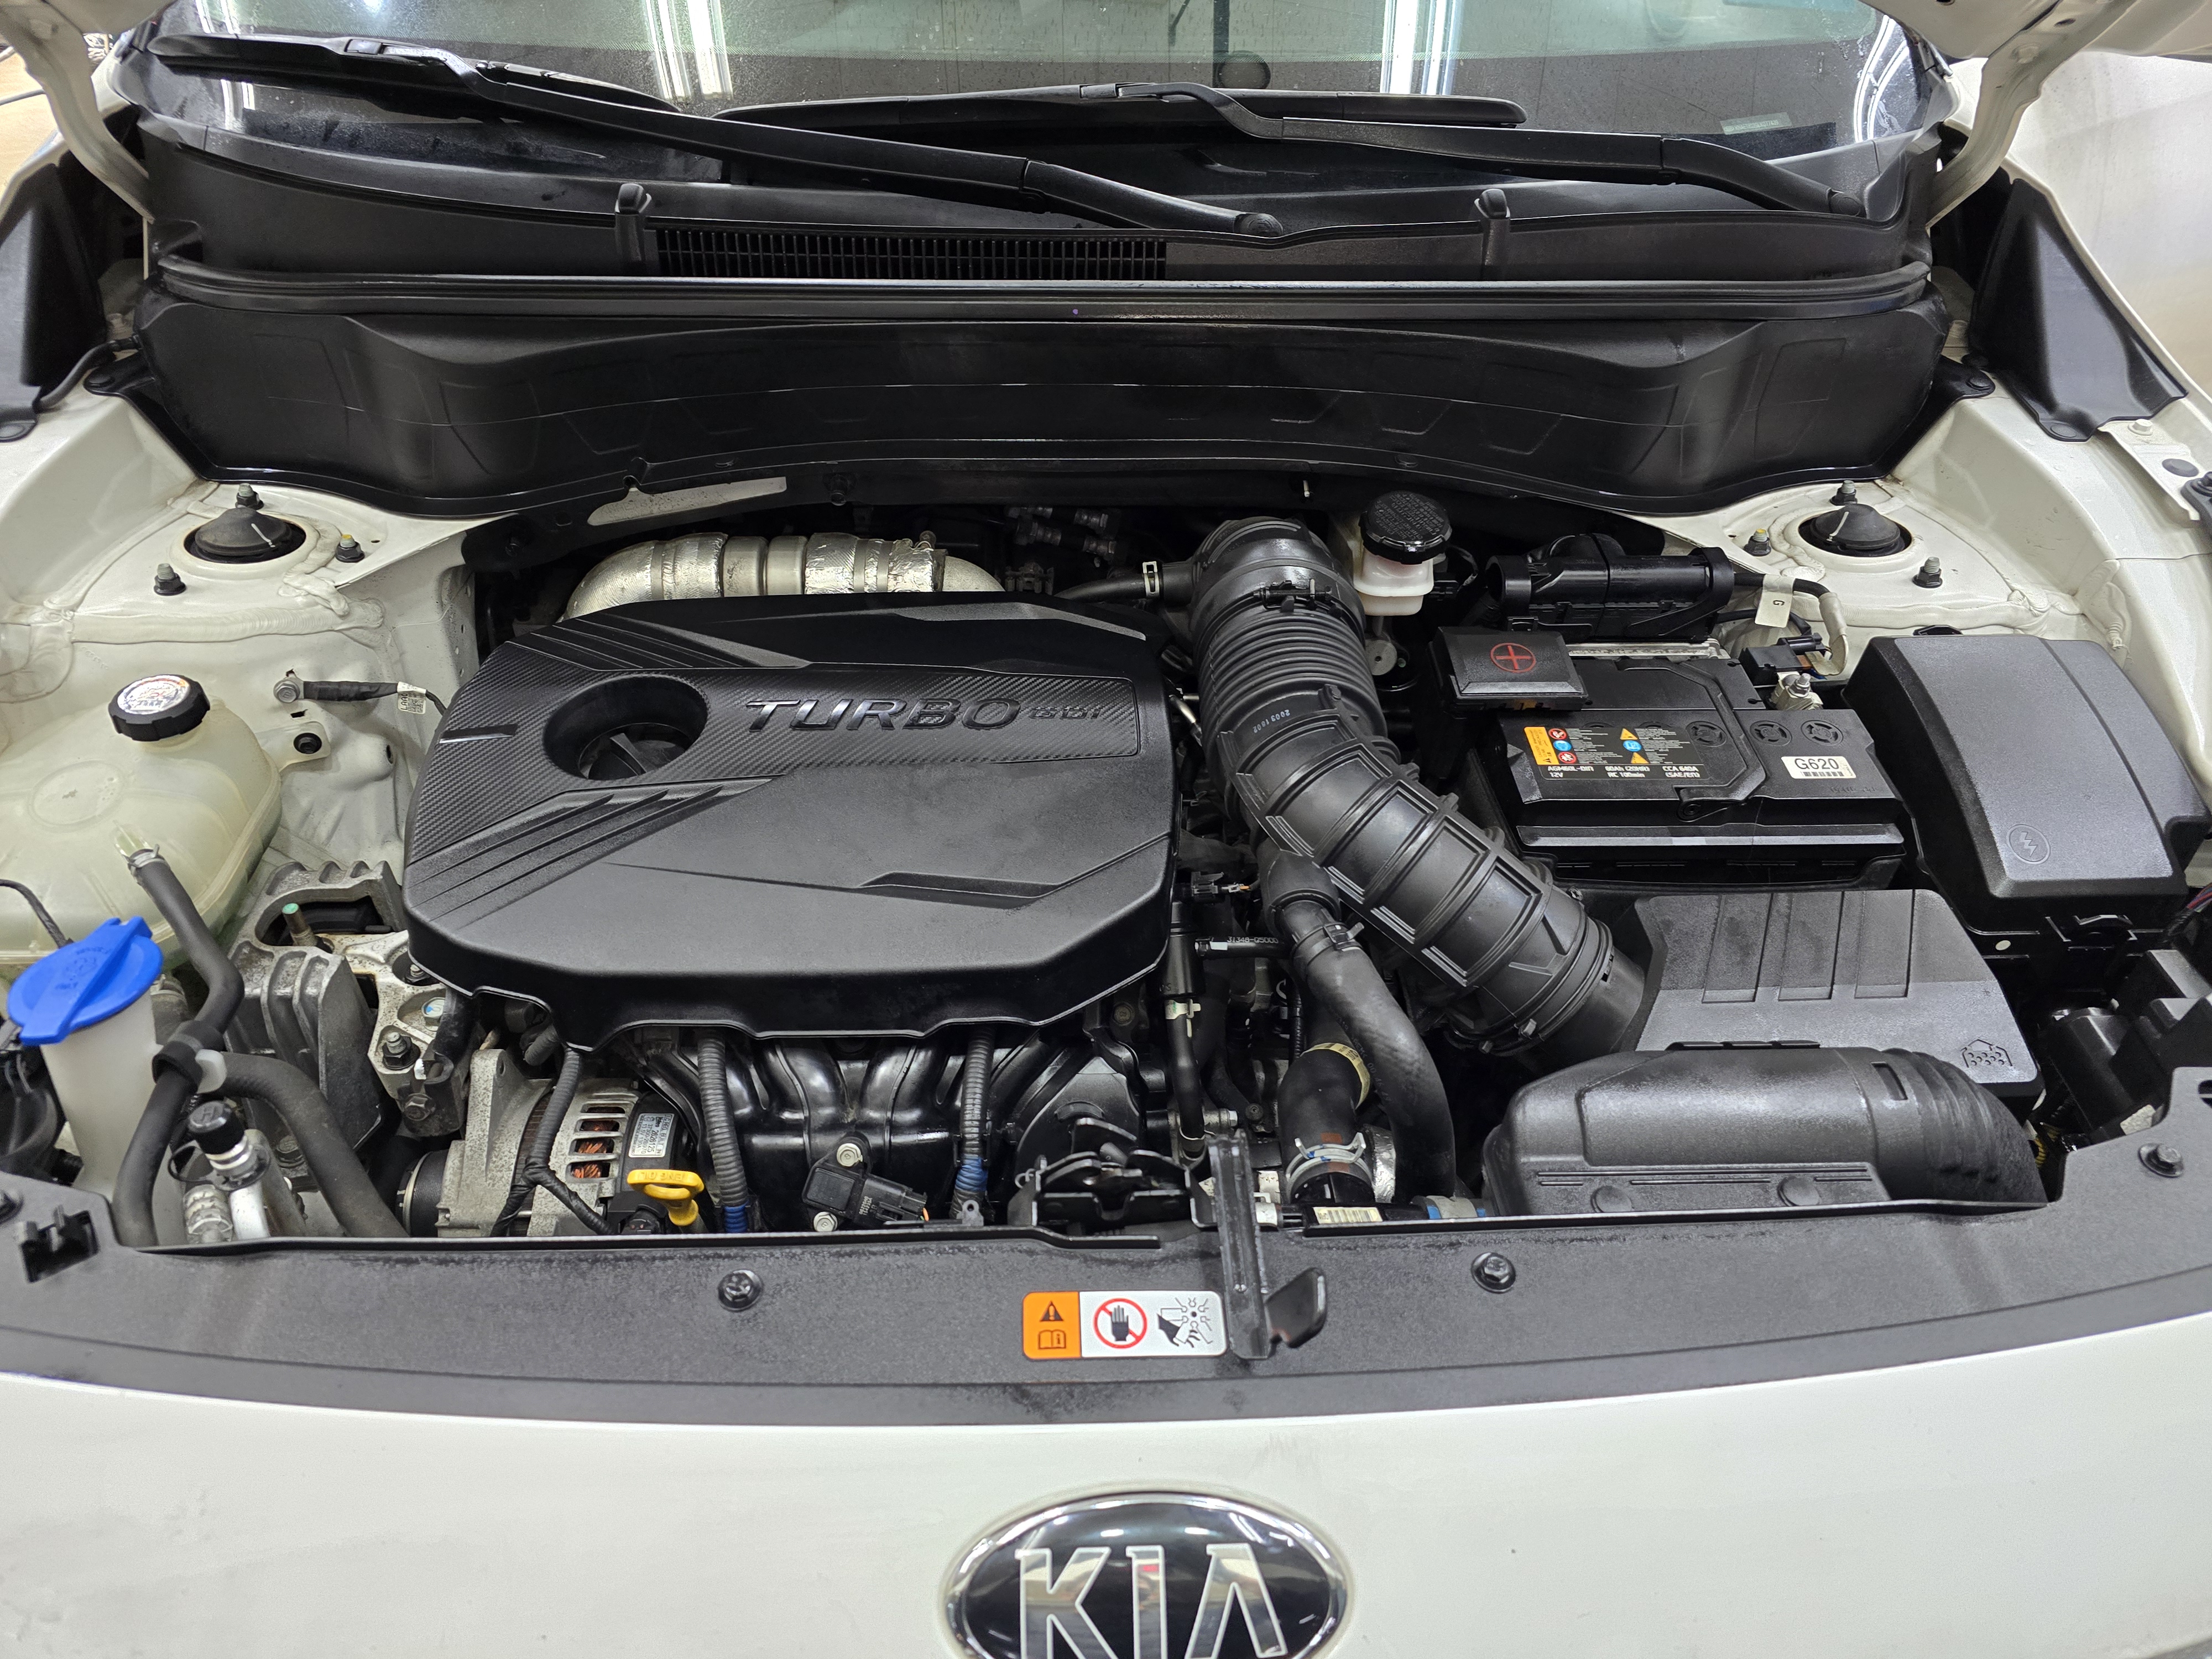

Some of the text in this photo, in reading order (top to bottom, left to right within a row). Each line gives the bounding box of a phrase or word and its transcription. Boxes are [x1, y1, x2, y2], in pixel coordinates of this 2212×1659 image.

[745, 697, 1021, 732] TURBO
[1794, 758, 1839, 770] G620
[660, 1172, 683, 1181] ENG
[1014, 1543, 1288, 1659] KIA
